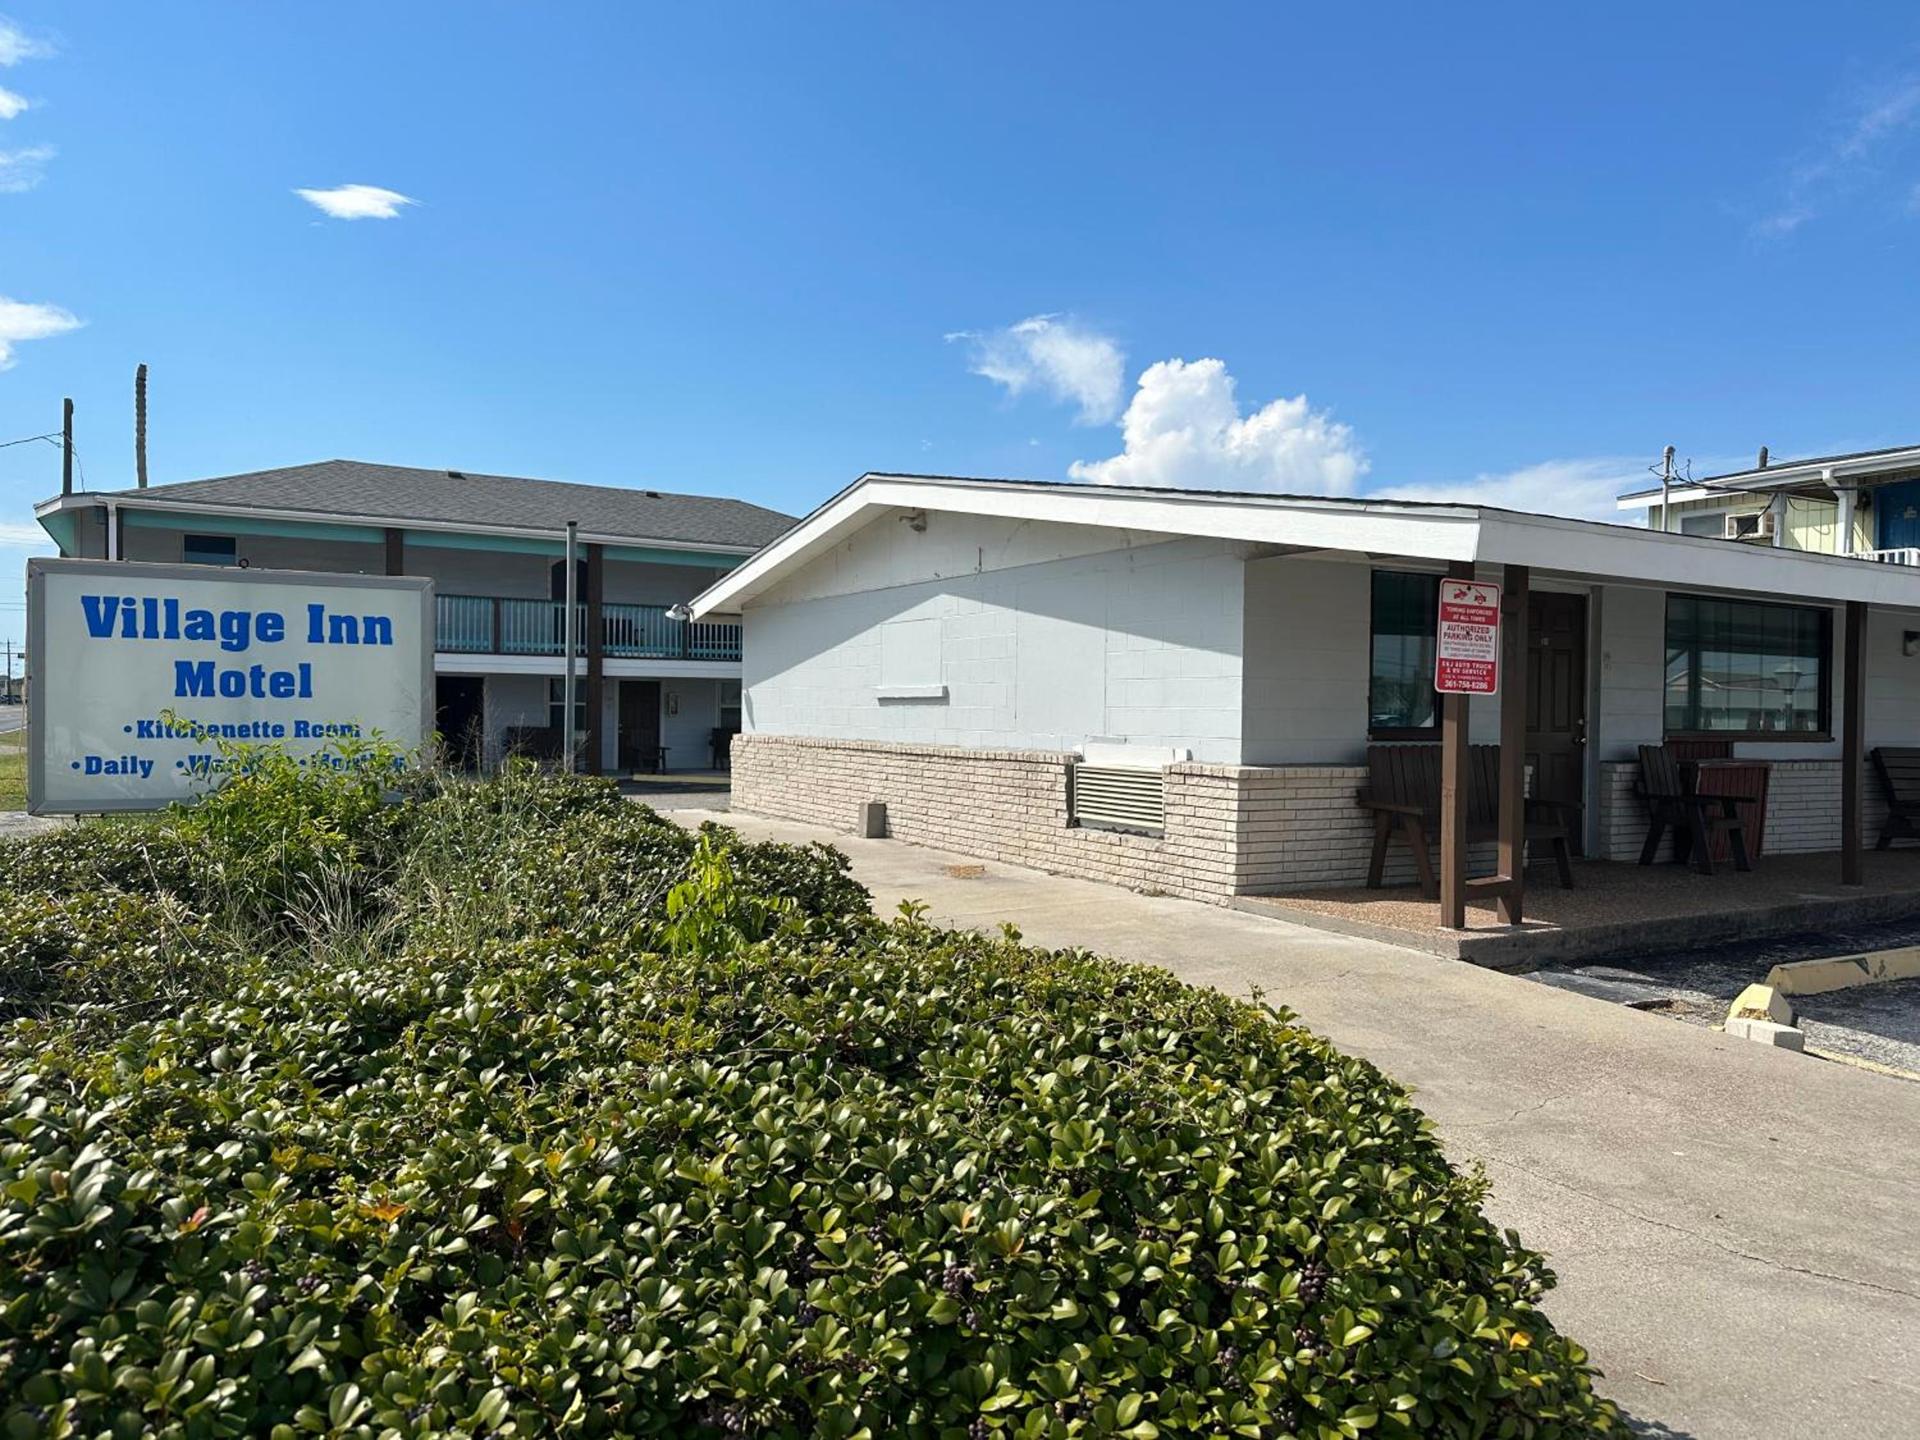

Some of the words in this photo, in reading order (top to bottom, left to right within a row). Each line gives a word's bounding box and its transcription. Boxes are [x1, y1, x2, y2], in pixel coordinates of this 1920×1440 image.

[81, 595, 285, 652] Village
[307, 604, 393, 645] Inn
[1447, 624, 1490, 634] AUTHORIZED
[1443, 631, 1474, 641] PARKING
[1474, 634, 1493, 642] ONLY
[175, 661, 312, 698] Motel
[85, 755, 154, 779] Daily
